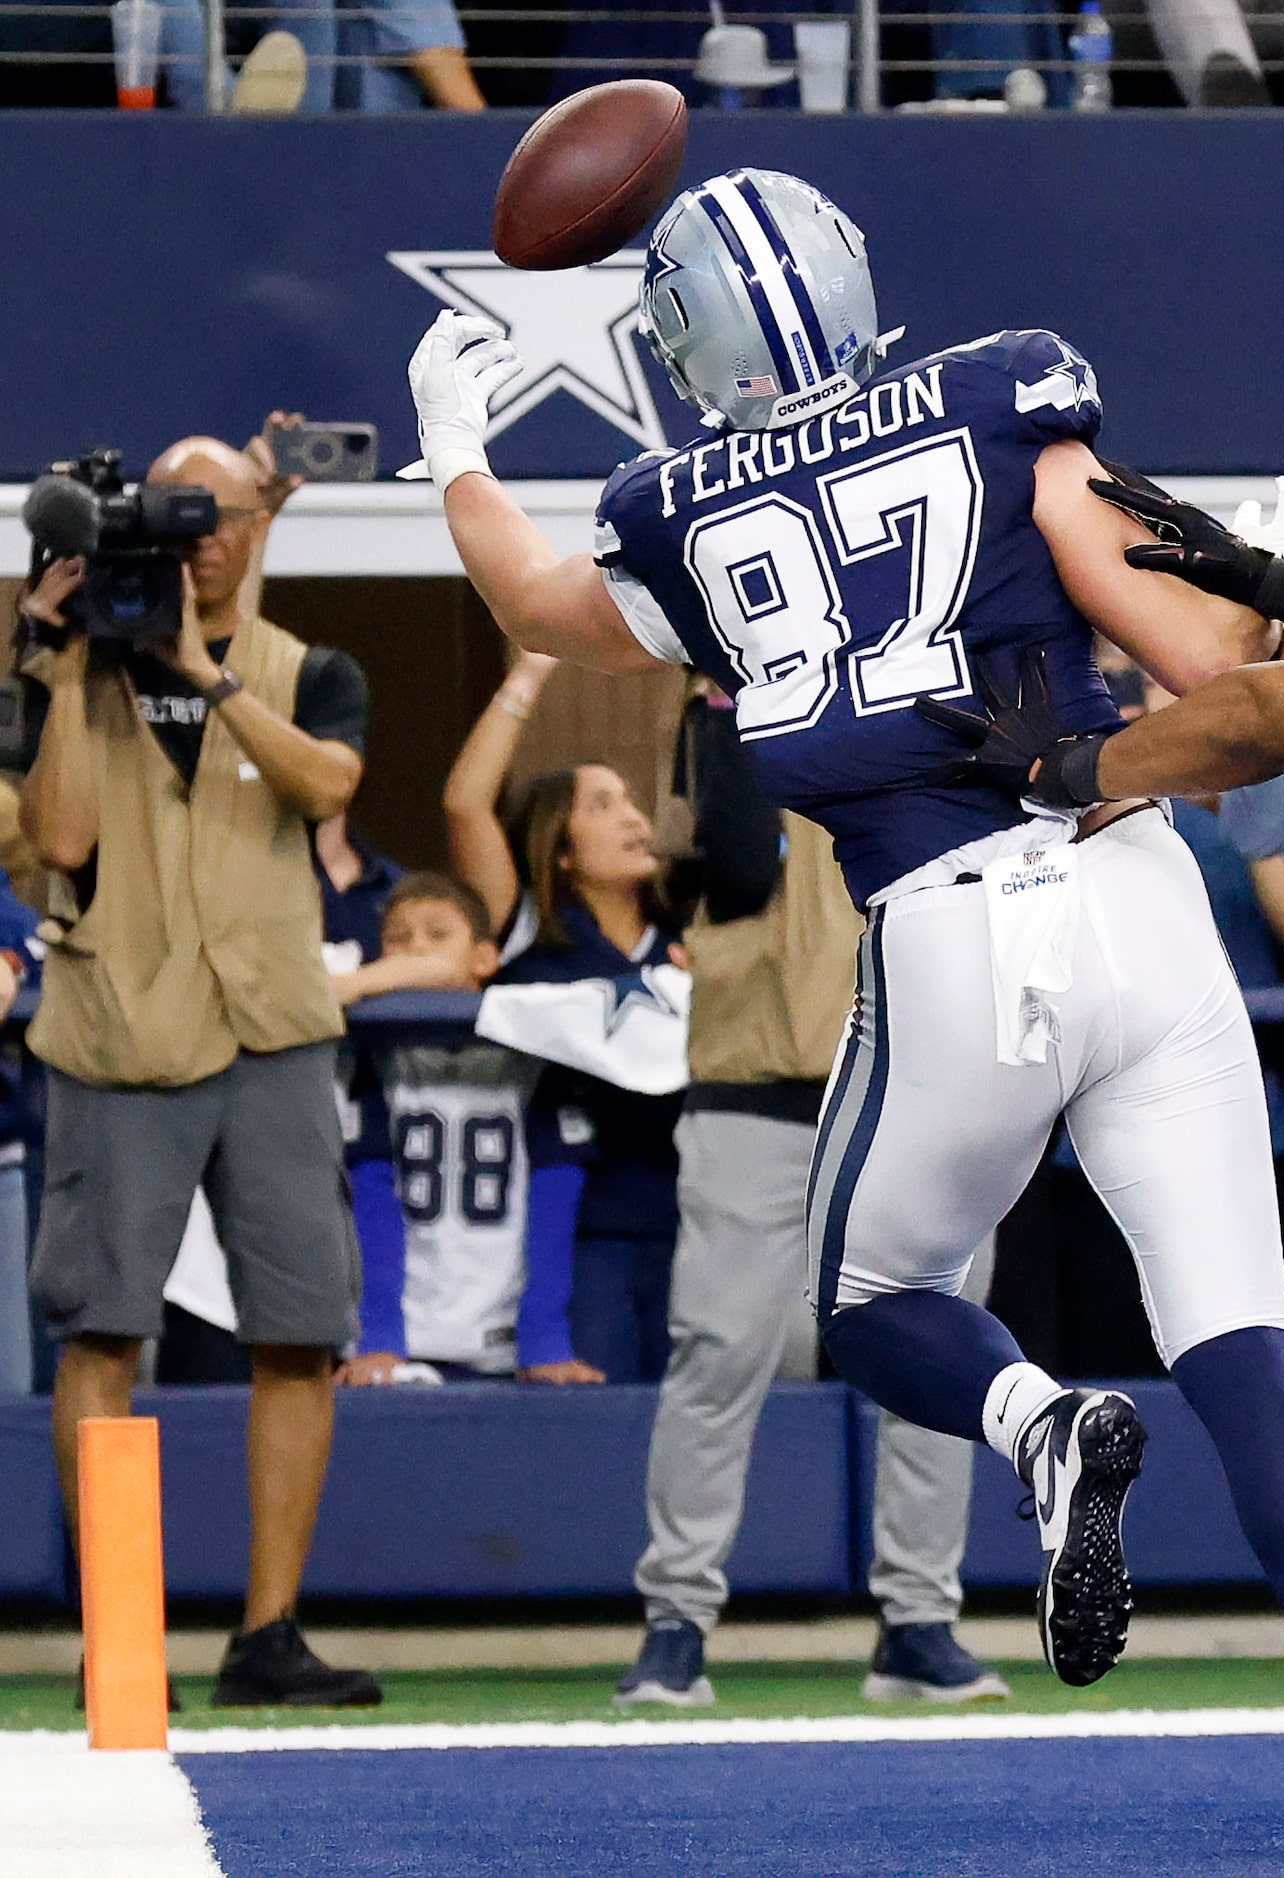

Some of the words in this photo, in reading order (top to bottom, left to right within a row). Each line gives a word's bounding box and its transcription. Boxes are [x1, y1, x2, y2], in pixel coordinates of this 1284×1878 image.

[659, 363, 945, 518] FERGUSON
[777, 379, 848, 417] COWBOYS
[683, 426, 985, 743] 87
[1002, 872, 1068, 895] CHANGE
[395, 1112, 514, 1223] 88
